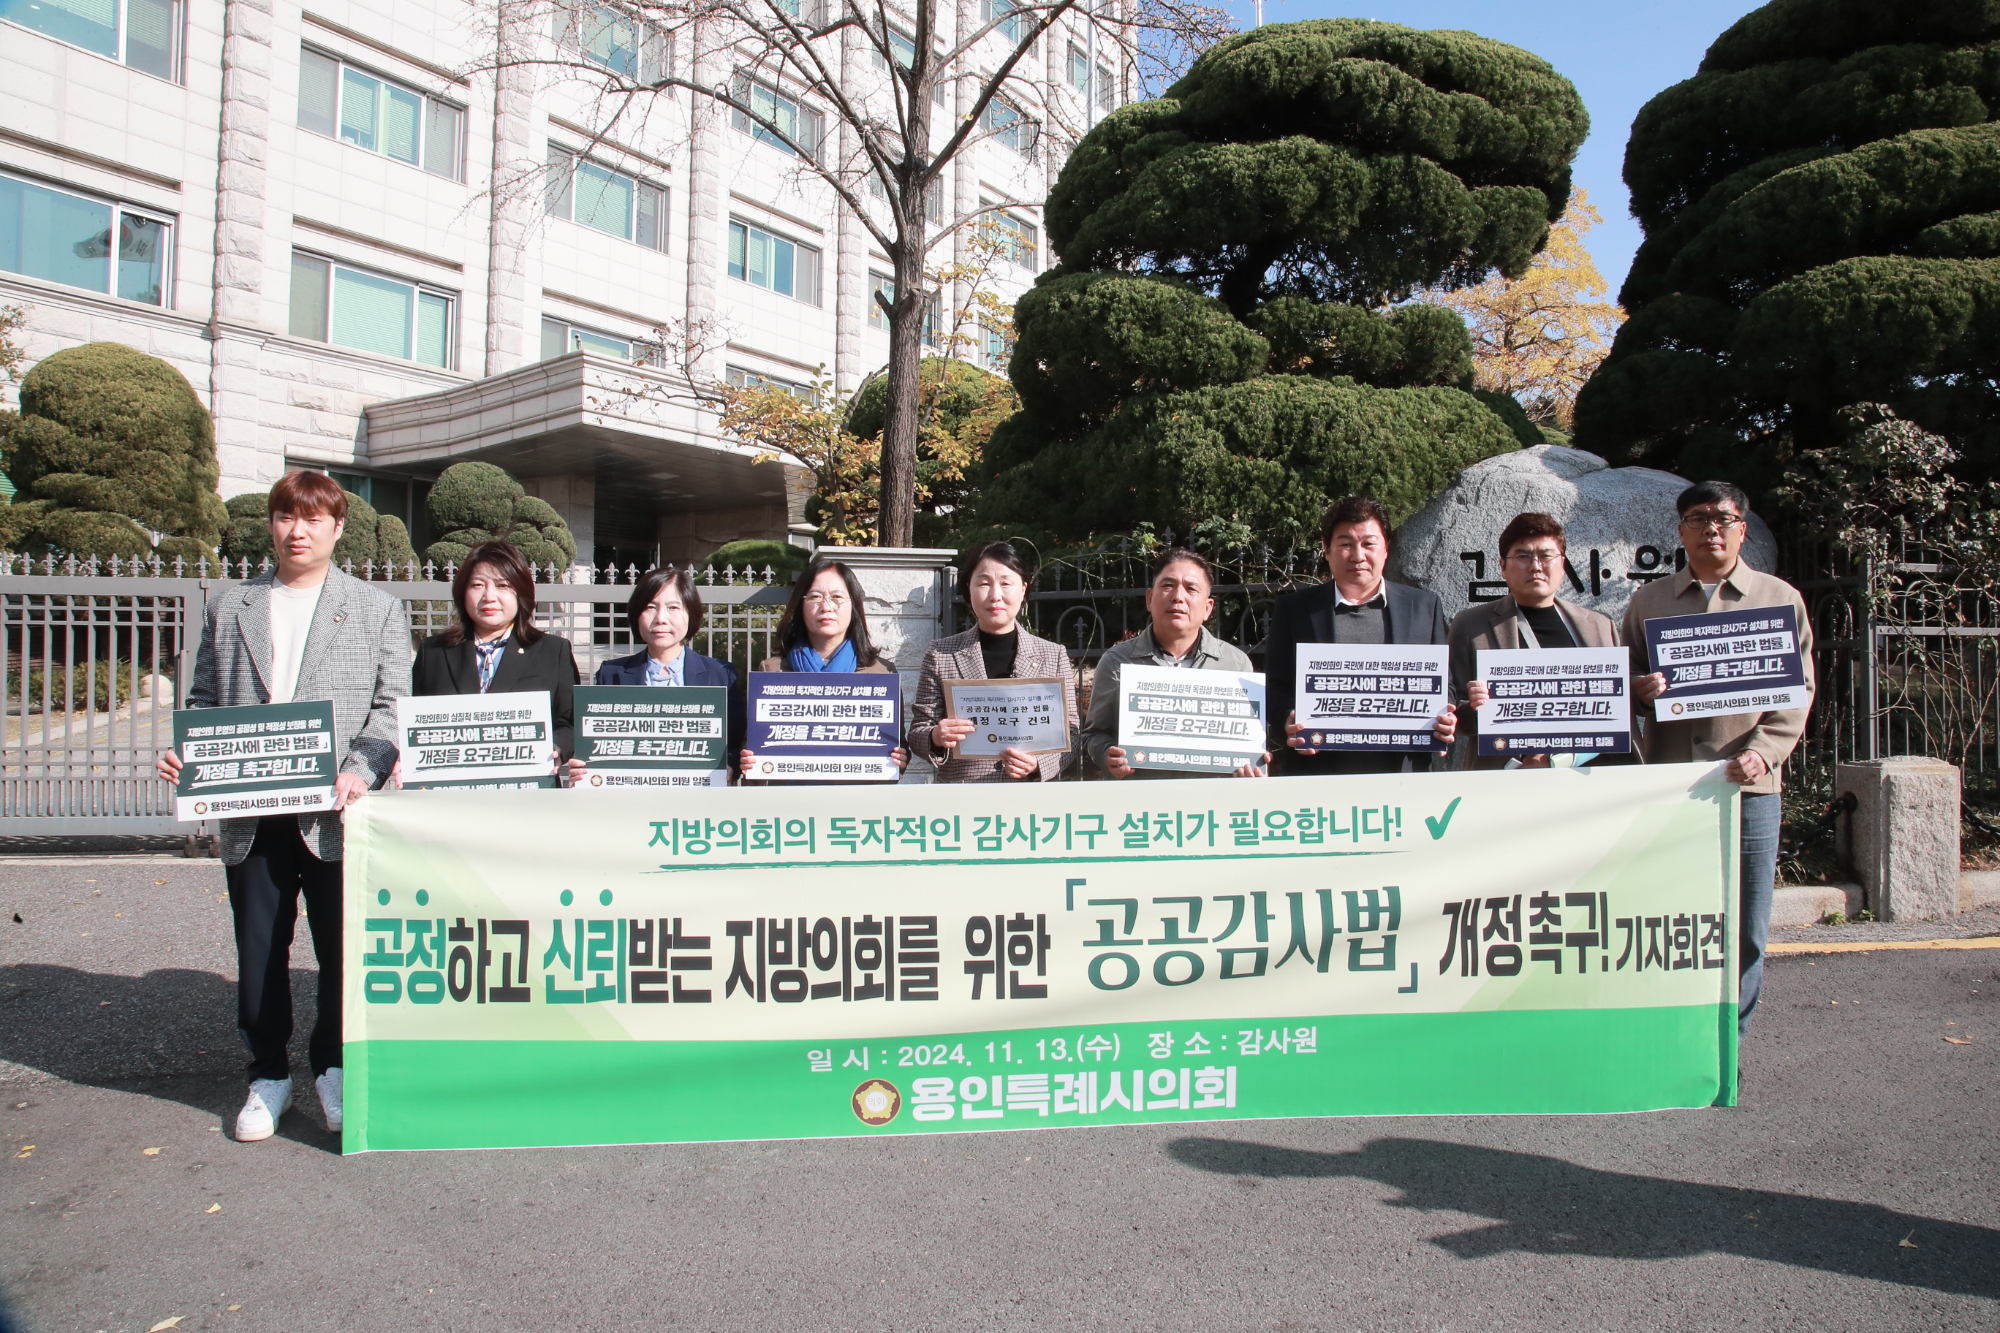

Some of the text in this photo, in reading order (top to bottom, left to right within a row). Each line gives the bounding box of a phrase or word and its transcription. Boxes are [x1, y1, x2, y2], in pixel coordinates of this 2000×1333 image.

[1661, 619, 1784, 640] 지방의회의 독자적인 감사기구 설치를 위한
[1732, 640, 1756, 653] 관한
[1309, 661, 1438, 671] 지방의회의 국민에 대한 책임성 담보를 위한
[1490, 664, 1619, 676] 지방의회의 국민에 대한 책임성 담보를 위한
[1672, 657, 1785, 681] 개정을 촉구합니다.
[762, 685, 887, 696] 지방의회의 독자적인 감사기구 설치를 위한
[1379, 678, 1405, 691] 관한
[1561, 681, 1586, 694] 관한
[1200, 701, 1225, 714] 관한
[1314, 698, 1430, 713] 개정을 요구합니다.
[1496, 701, 1612, 717] 개정을 요구합니다.
[1686, 694, 1791, 712] 용인특례시의회 의원 일동
[415, 710, 532, 724] 지방의회의 실질적 독립성 확보를 위한
[832, 705, 856, 717] 관한
[658, 720, 683, 733] 관한
[968, 716, 1050, 726] 개정 요구 건의
[1137, 716, 1249, 736] 개정을 요구합니다.
[482, 726, 508, 741] 관한
[767, 725, 881, 740] 개정을 촉구합니다.
[1326, 734, 1431, 745] 용인특례시의회 의원 일동
[264, 738, 290, 752] 관한
[592, 740, 710, 755] 개정을 촉구합니다.
[1509, 737, 1614, 749] 용인특례시의회 의원 일동
[419, 745, 535, 764] 개정을 요구합니다.
[1149, 752, 1211, 765] 용인특례시의회
[1213, 756, 1231, 766] 의원
[194, 757, 319, 781] 개정을 촉구합니다.
[777, 763, 883, 773] 용인특례시의회 의원 일동
[606, 776, 711, 786] 용인특례시의회 의원 일동
[211, 794, 322, 812] 용인특례시의회 의원 일동
[648, 805, 1402, 855] 지방의회의 독자적인 감사기구 설치가 필요합니다!
[363, 918, 531, 1004] 공정하고
[543, 918, 712, 1004] 신뢰받는
[726, 913, 939, 1005] 지방의회를
[964, 911, 1056, 1000] 위한
[898, 1043, 972, 1066] 2024.
[985, 1040, 1022, 1064] 11.
[1237, 1026, 1317, 1056] 감사원
[911, 1066, 1237, 1122] 용인특례시의회
